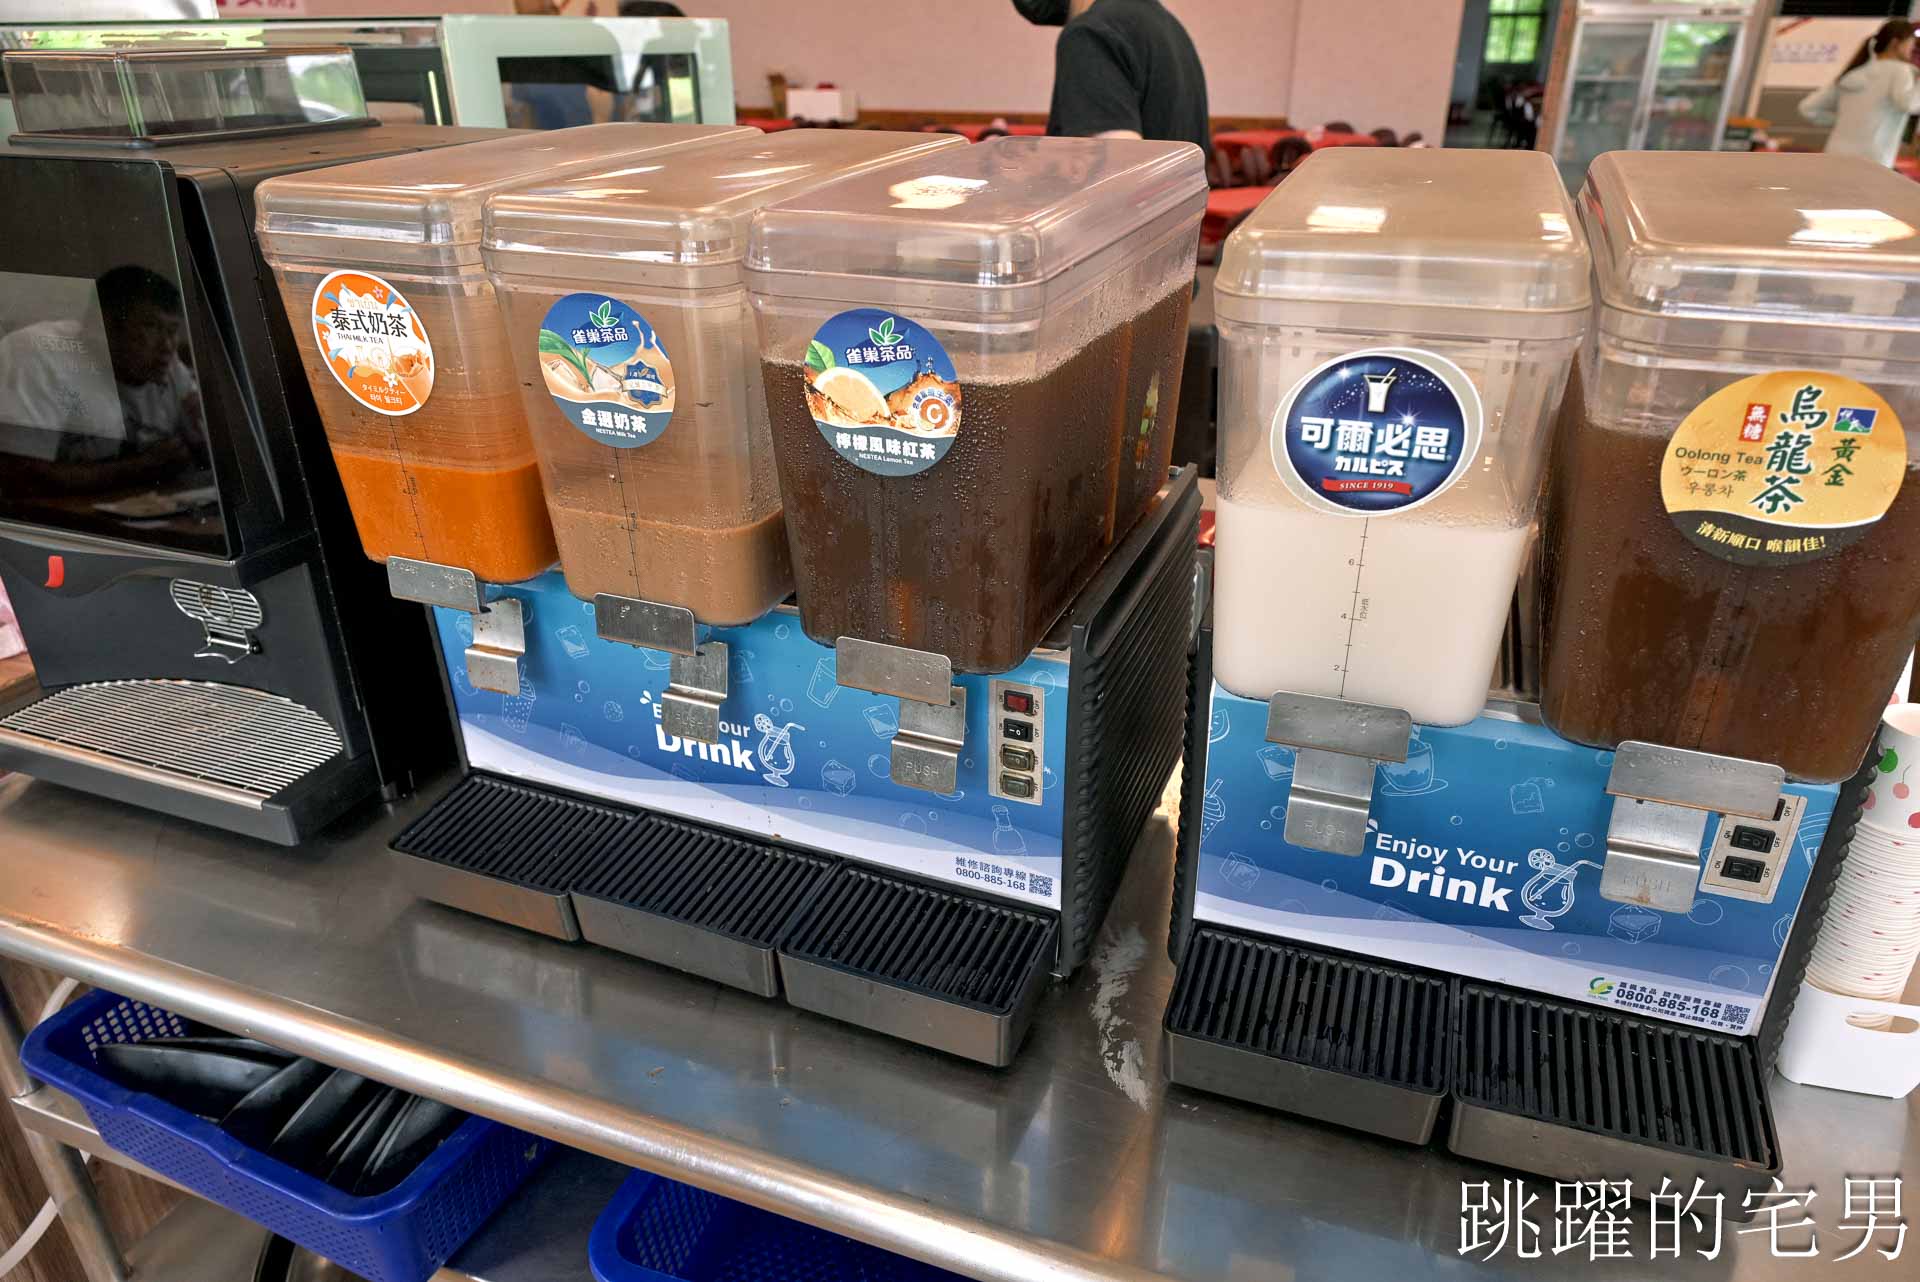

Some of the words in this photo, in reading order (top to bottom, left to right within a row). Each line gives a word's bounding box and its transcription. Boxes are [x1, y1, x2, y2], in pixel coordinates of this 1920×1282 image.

[331, 307, 408, 338] 泰式奶茶
[336, 332, 352, 341] THAI
[353, 334, 369, 343] MILK
[369, 336, 384, 344] TEA
[572, 326, 629, 344] 雀巢茶品
[845, 344, 913, 364] 雀巢茶品
[1742, 404, 1767, 441] 無糖
[835, 431, 936, 460] 檸檬風味紅茶
[1300, 415, 1450, 462] 可爾必思
[859, 452, 882, 461] NESTEA
[1675, 447, 1731, 465] Oolong
[1737, 451, 1764, 465] Tea
[1749, 384, 1829, 515] 烏龍茶
[1334, 455, 1405, 476] カルピス
[1821, 437, 1862, 487] 黃金
[1680, 465, 1748, 482] ウーロン茶
[1339, 480, 1370, 490] SINCE
[1371, 480, 1395, 490] 1919
[1687, 481, 1735, 499] 우롱차
[1333, 664, 1340, 672] 2
[719, 721, 750, 738] our
[655, 724, 756, 772] Drink
[906, 761, 939, 778] PUSH
[1783, 805, 1792, 817] OFF
[1773, 837, 1781, 848] OFF
[1376, 832, 1448, 866] Enjoy
[1457, 847, 1519, 876] Your
[955, 856, 1027, 880] 維修諮詢專線
[1714, 860, 1721, 869] ON
[1763, 867, 1771, 878] OFF
[955, 867, 1026, 891] 0800-885-168
[1369, 855, 1514, 913] Drink
[1616, 988, 1721, 1019] 0800-885-168
